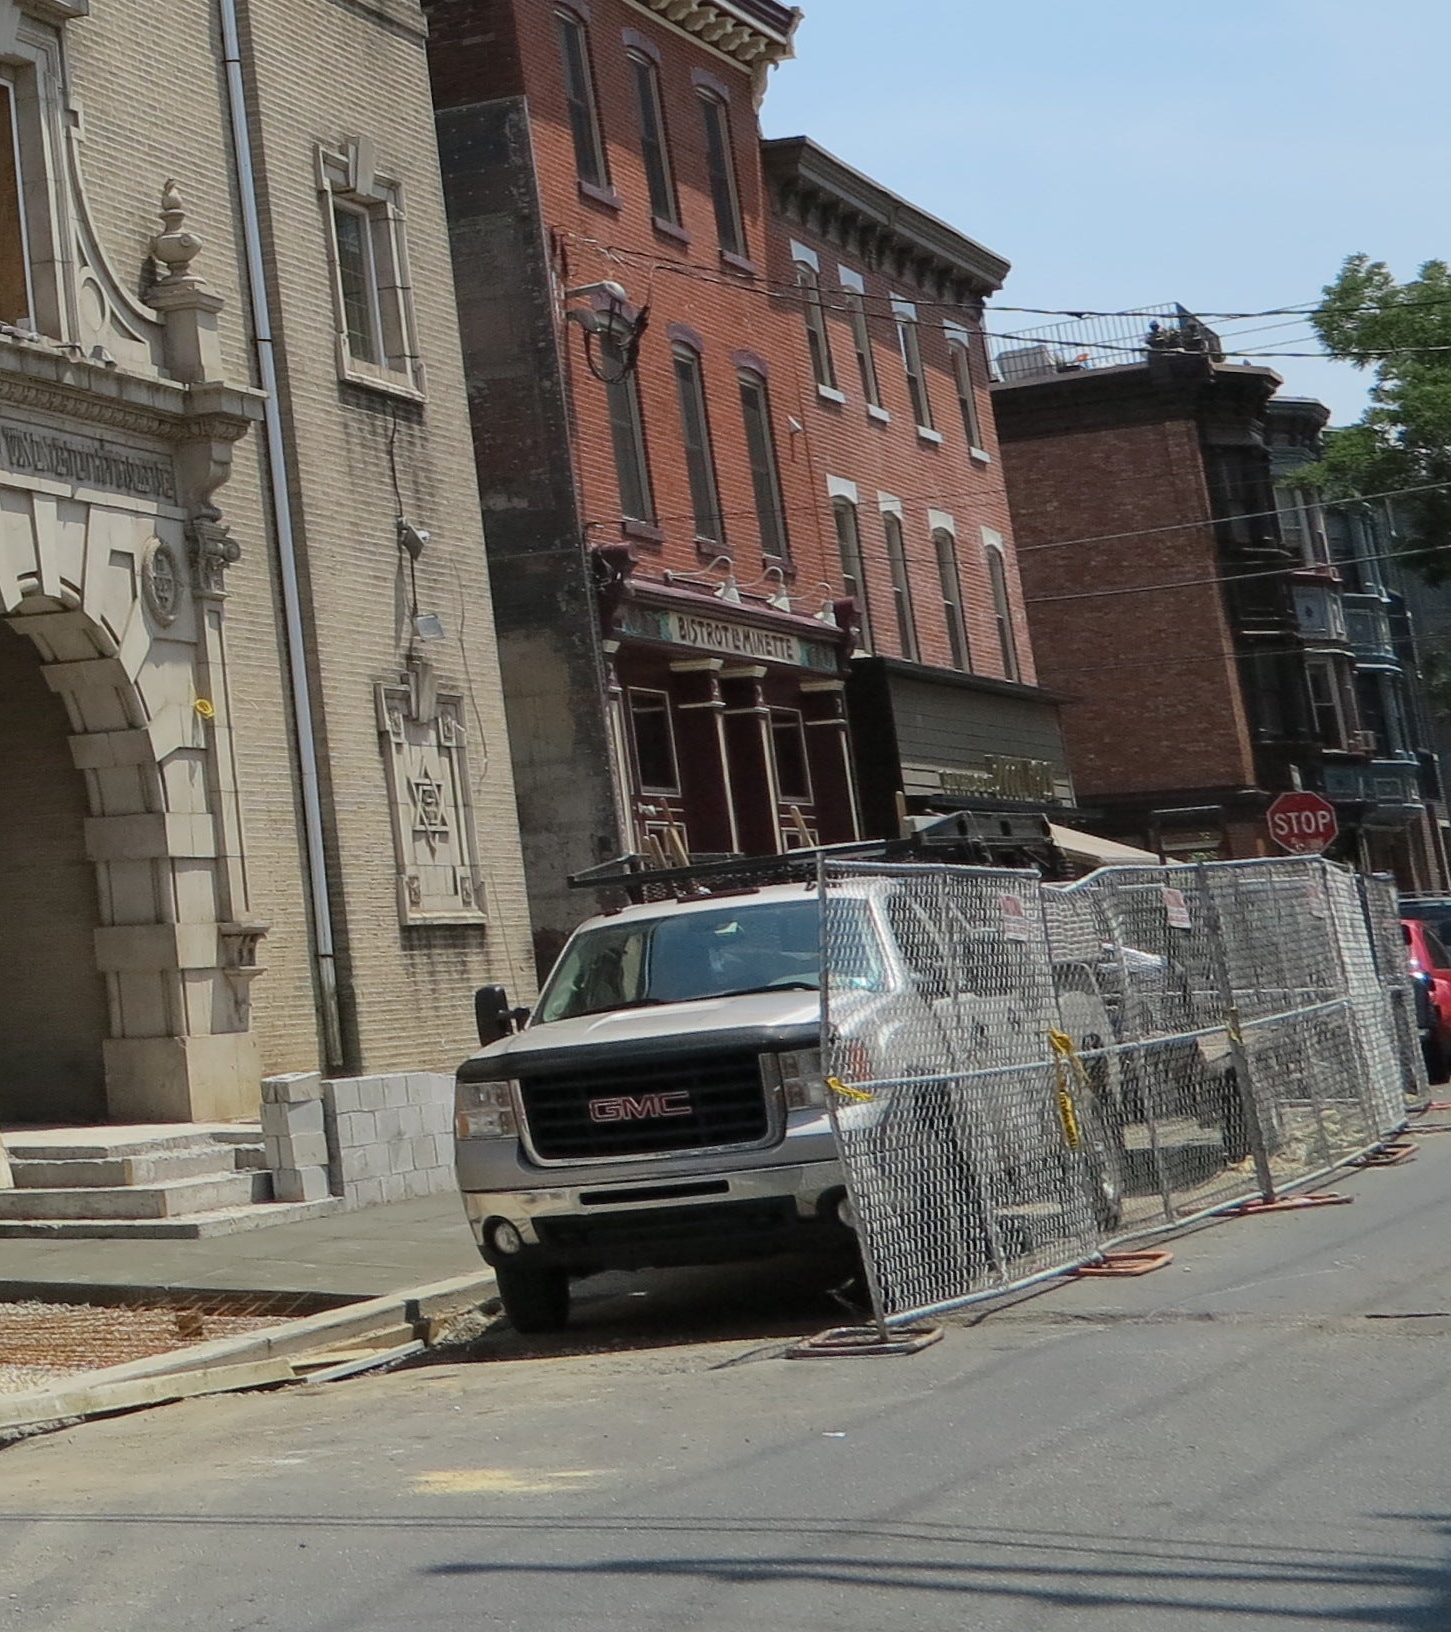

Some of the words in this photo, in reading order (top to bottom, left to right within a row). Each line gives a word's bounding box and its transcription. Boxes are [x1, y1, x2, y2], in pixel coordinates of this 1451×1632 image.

[677, 616, 729, 648] BISTROT
[742, 629, 794, 660] MINETTE
[1273, 811, 1331, 836] STOP
[588, 1090, 693, 1123] GMC
